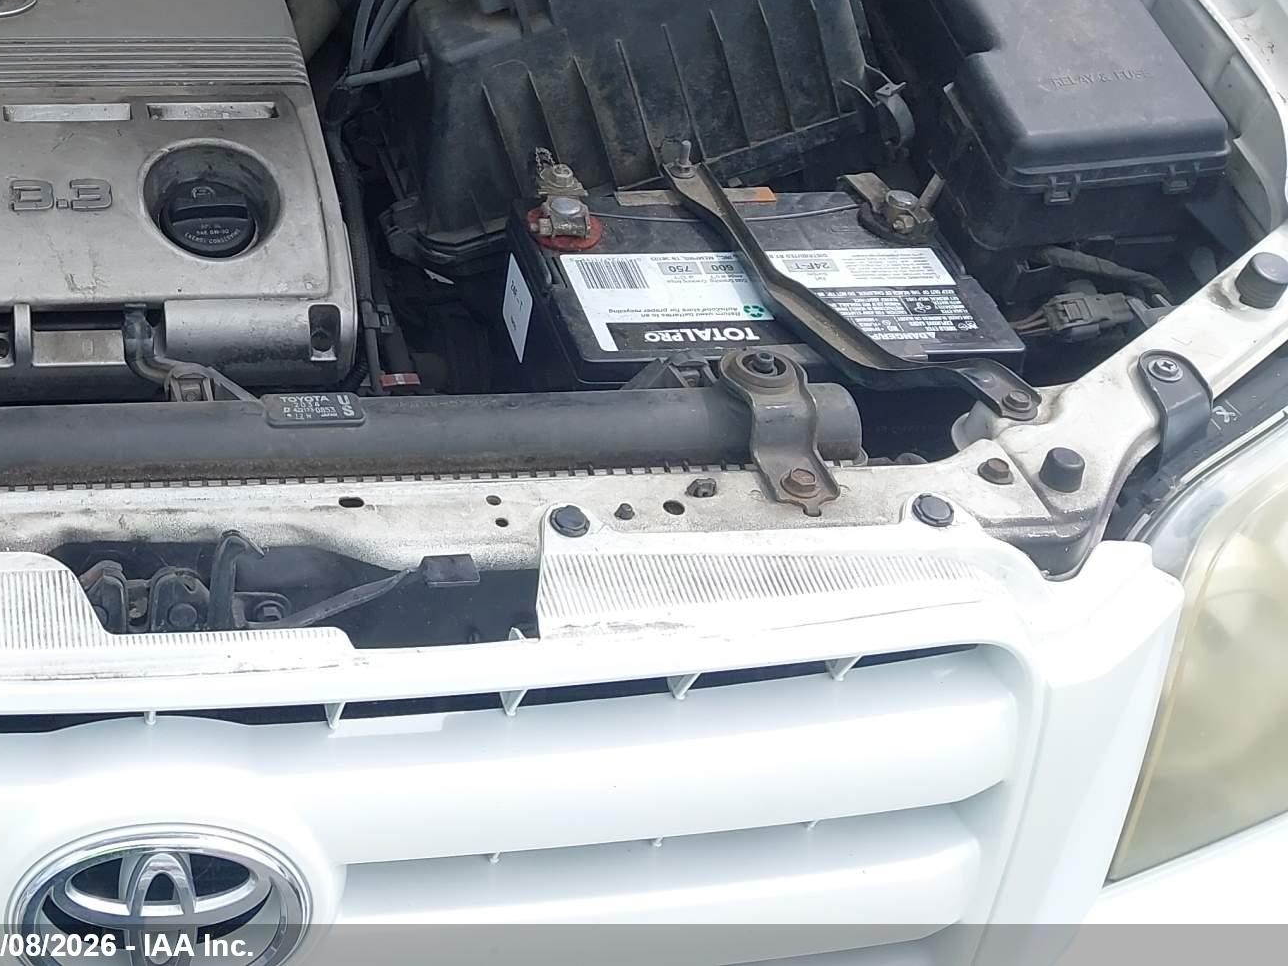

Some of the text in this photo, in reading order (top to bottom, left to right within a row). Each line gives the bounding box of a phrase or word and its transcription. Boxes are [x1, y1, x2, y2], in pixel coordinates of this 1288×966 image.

[1051, 73, 1094, 88] RELAY
[10, 176, 114, 212] 3.3
[711, 264, 734, 272] 600
[644, 327, 760, 342] TOTALPRO
[867, 332, 928, 340] DANGER/P
